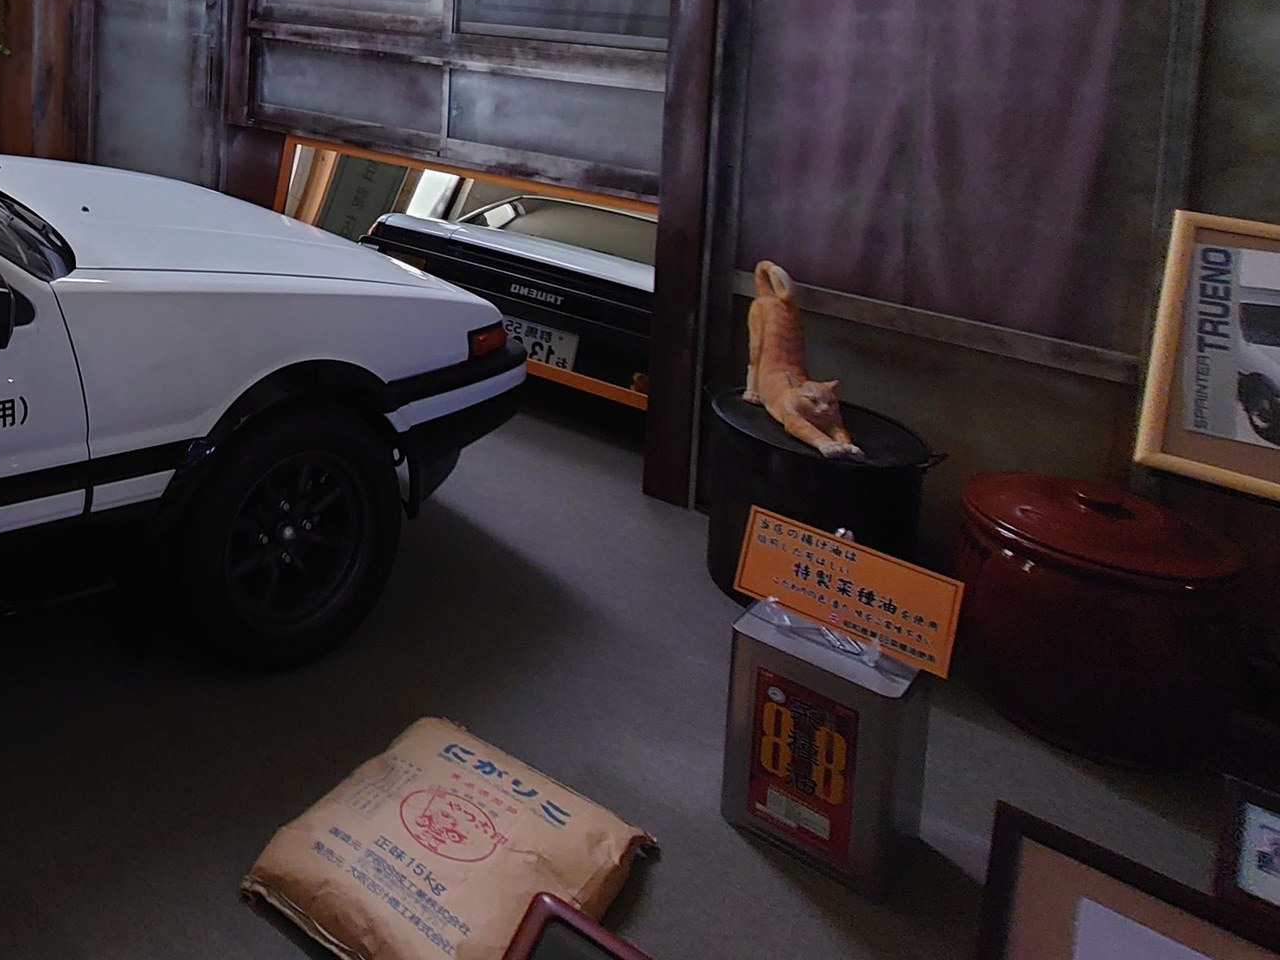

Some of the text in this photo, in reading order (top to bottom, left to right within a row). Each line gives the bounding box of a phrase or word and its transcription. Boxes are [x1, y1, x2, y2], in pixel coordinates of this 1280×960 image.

[1194, 246, 1233, 431] SPRINTER TRUENO
[759, 518, 857, 563] 当店の揚げ油は
